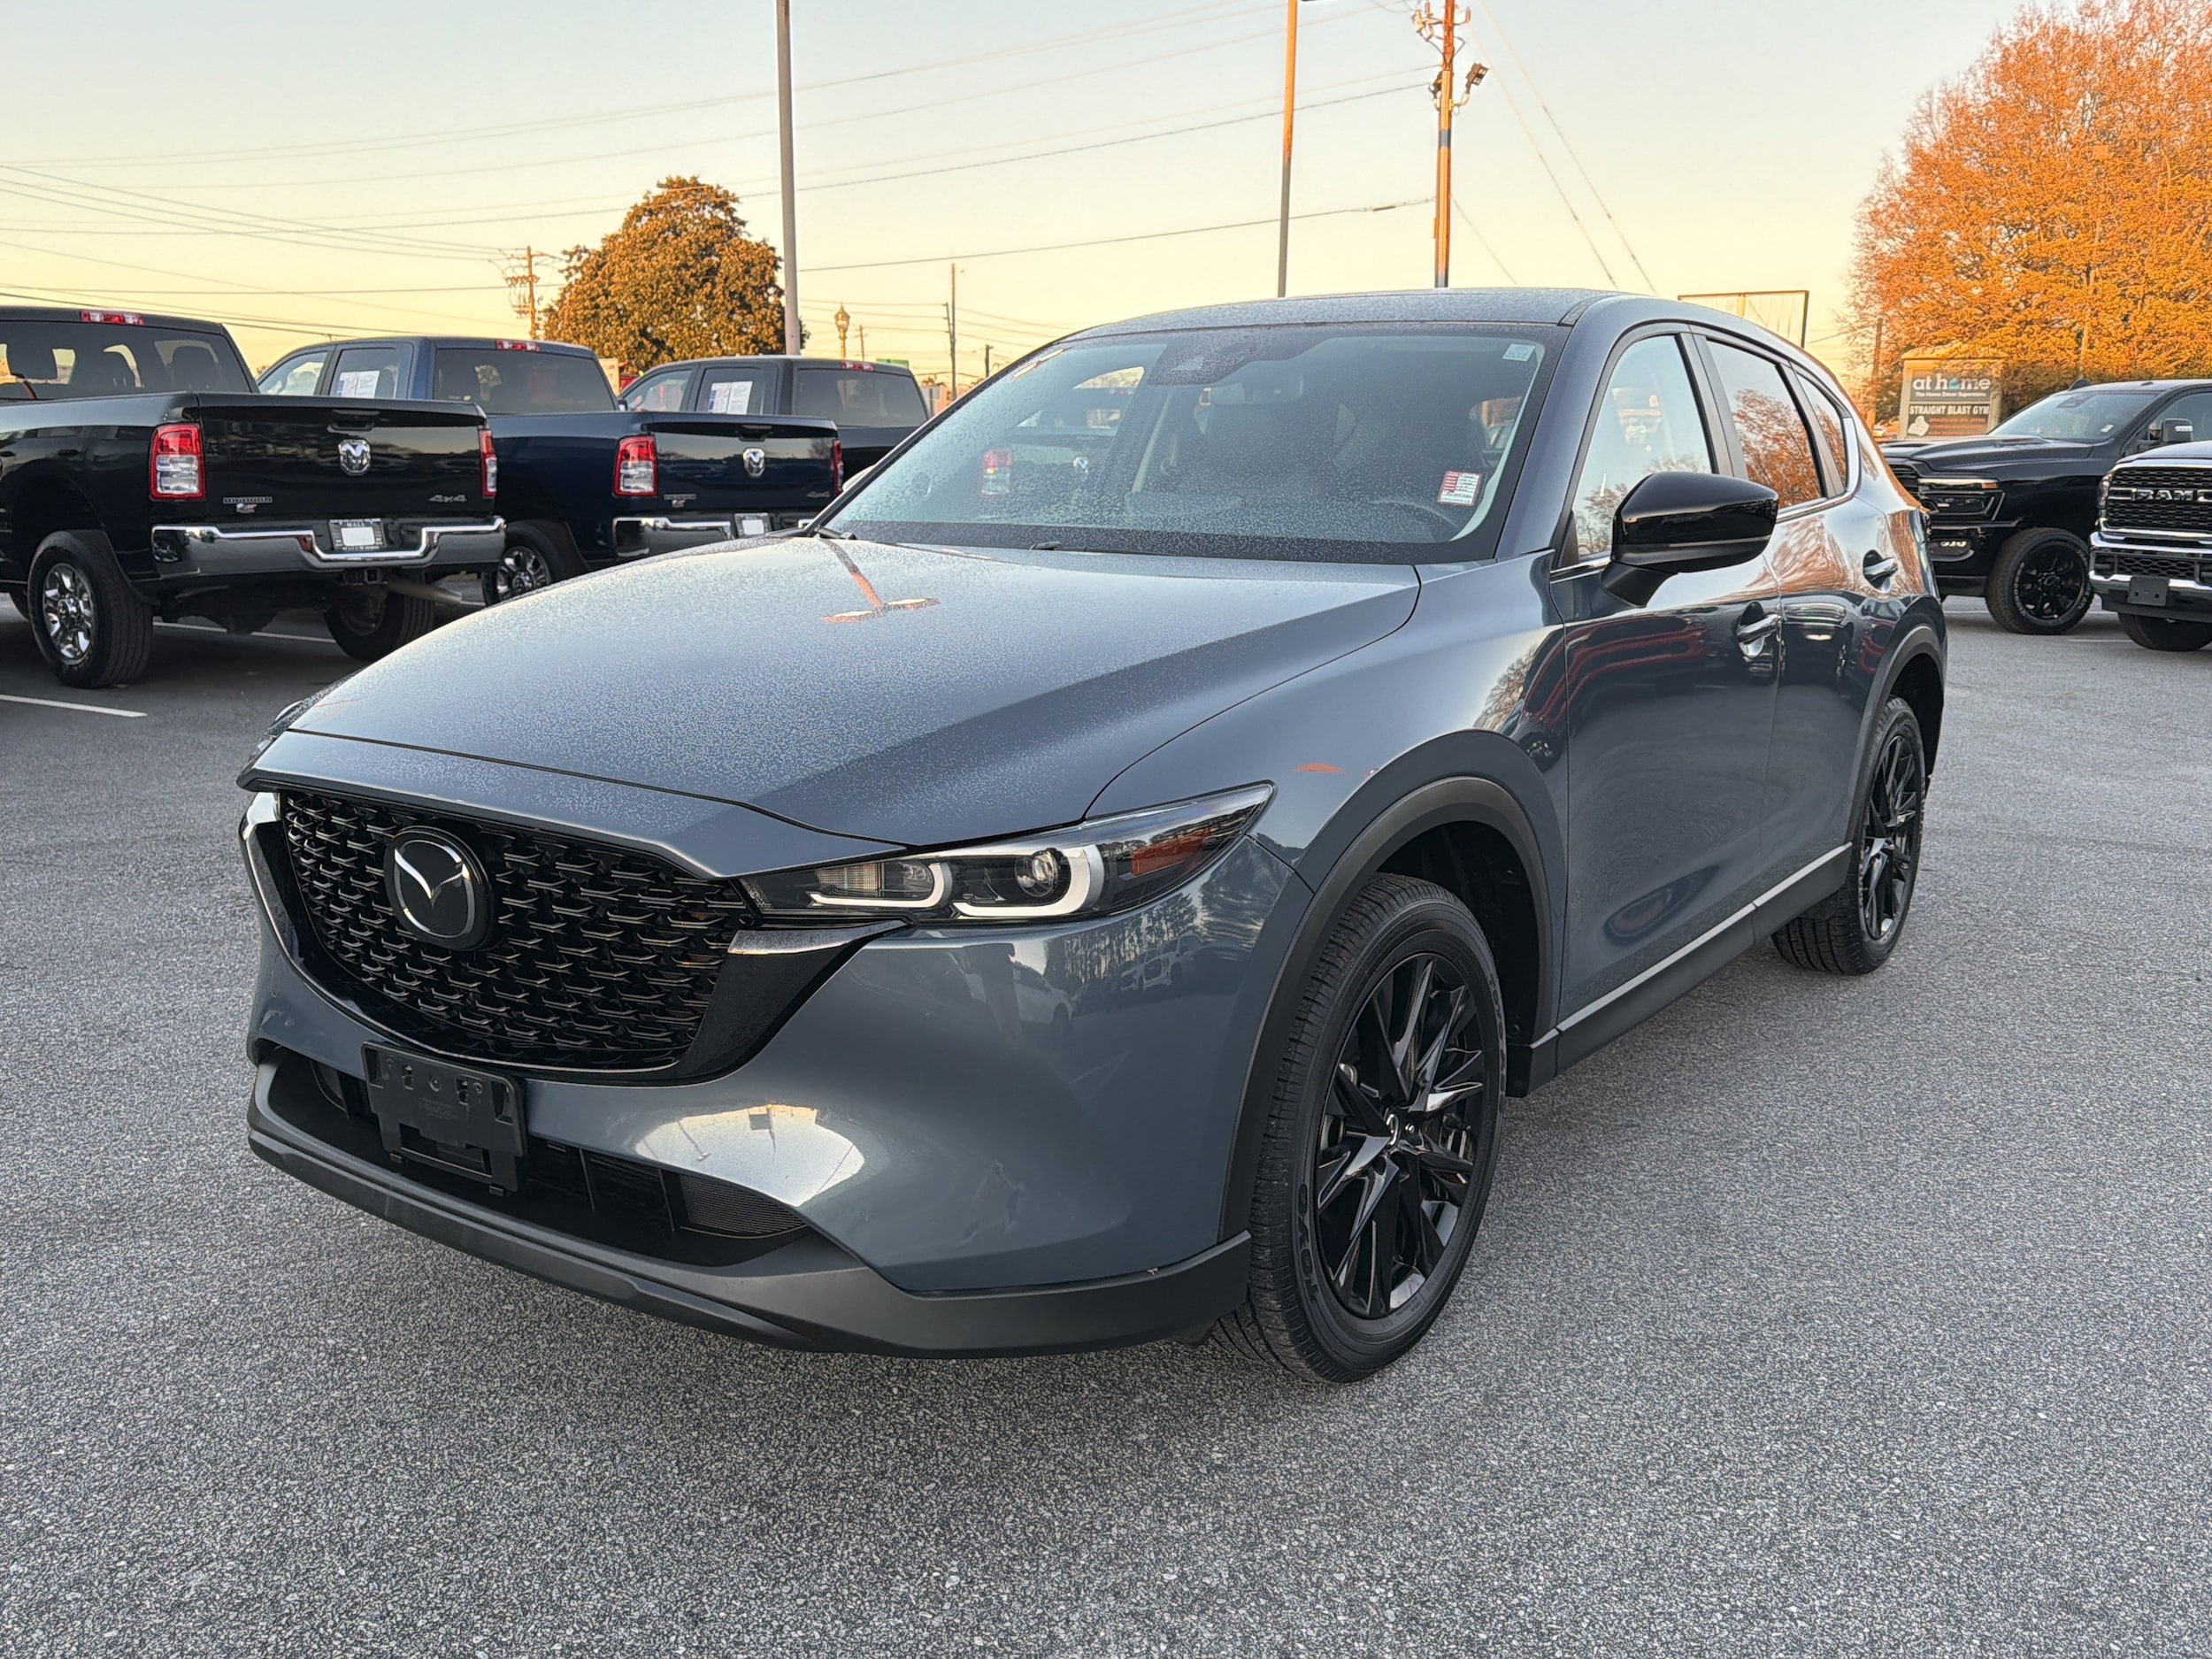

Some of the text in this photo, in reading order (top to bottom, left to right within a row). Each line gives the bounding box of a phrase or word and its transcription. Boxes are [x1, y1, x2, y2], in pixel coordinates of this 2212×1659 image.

[1912, 373, 1991, 390] at home
[1909, 405, 1990, 415] STRAIGHT BLAST GYM
[2136, 489, 2194, 501] RAM
[1297, 1182, 1318, 1304] TOYO
